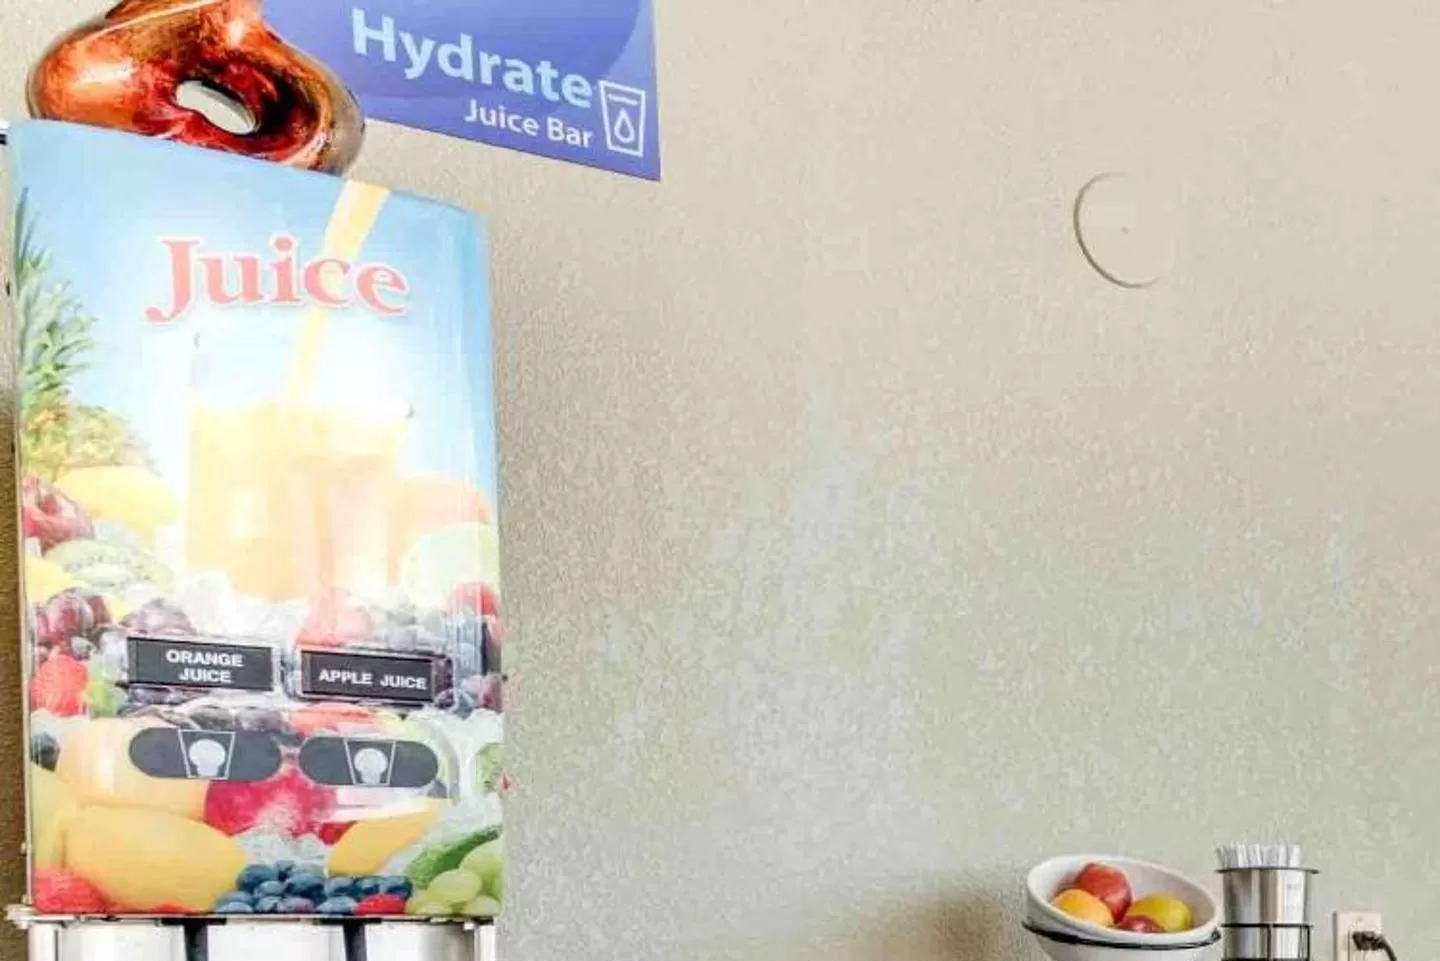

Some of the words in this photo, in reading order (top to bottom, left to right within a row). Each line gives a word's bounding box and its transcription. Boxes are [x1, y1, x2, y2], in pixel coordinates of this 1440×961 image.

[351, 8, 592, 109] Hydrate
[464, 100, 539, 137] Juice
[547, 118, 595, 148] Bar
[144, 234, 408, 324] Juice
[165, 649, 244, 667] ORANGE
[178, 668, 232, 683] JUICE
[318, 670, 372, 686] APPLE
[379, 673, 427, 690] JUICE
